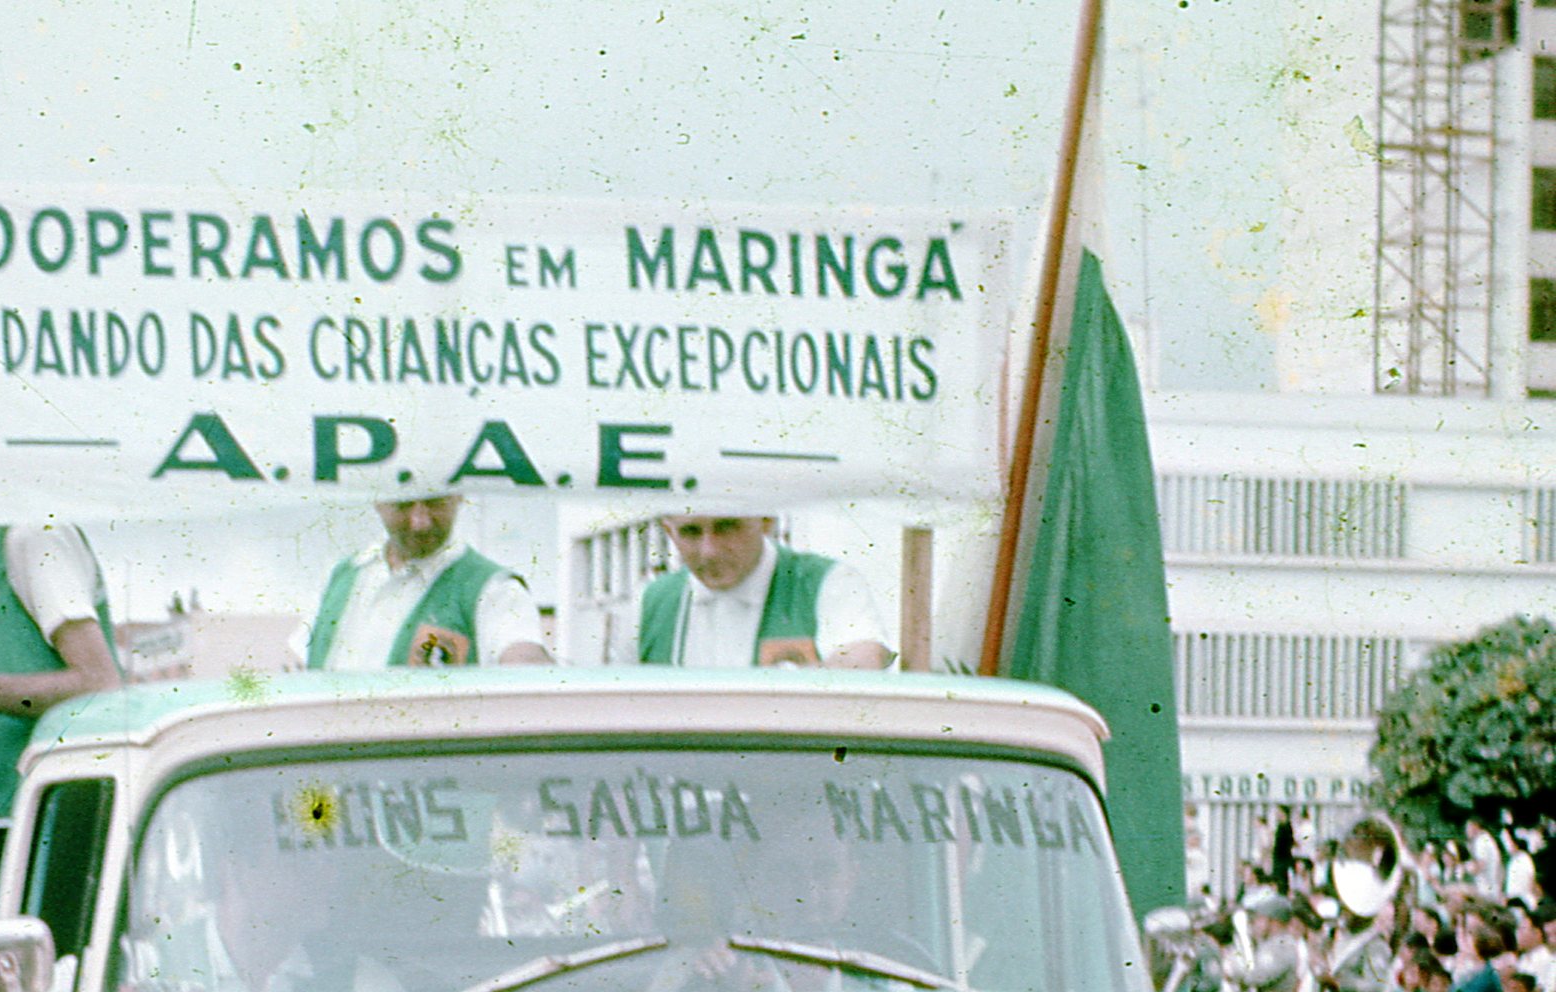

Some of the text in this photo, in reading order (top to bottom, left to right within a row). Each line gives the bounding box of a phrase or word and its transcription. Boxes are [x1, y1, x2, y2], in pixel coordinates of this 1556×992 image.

[505, 244, 578, 288] EM
[625, 220, 964, 300] MARINGÁ
[190, 312, 286, 380] DAS
[309, 315, 562, 397] CRIANÇAS
[584, 324, 939, 401] EXCEPCIONAIS
[149, 412, 698, 490] A.P.A.E.
[1182, 774, 1271, 797] STADO
